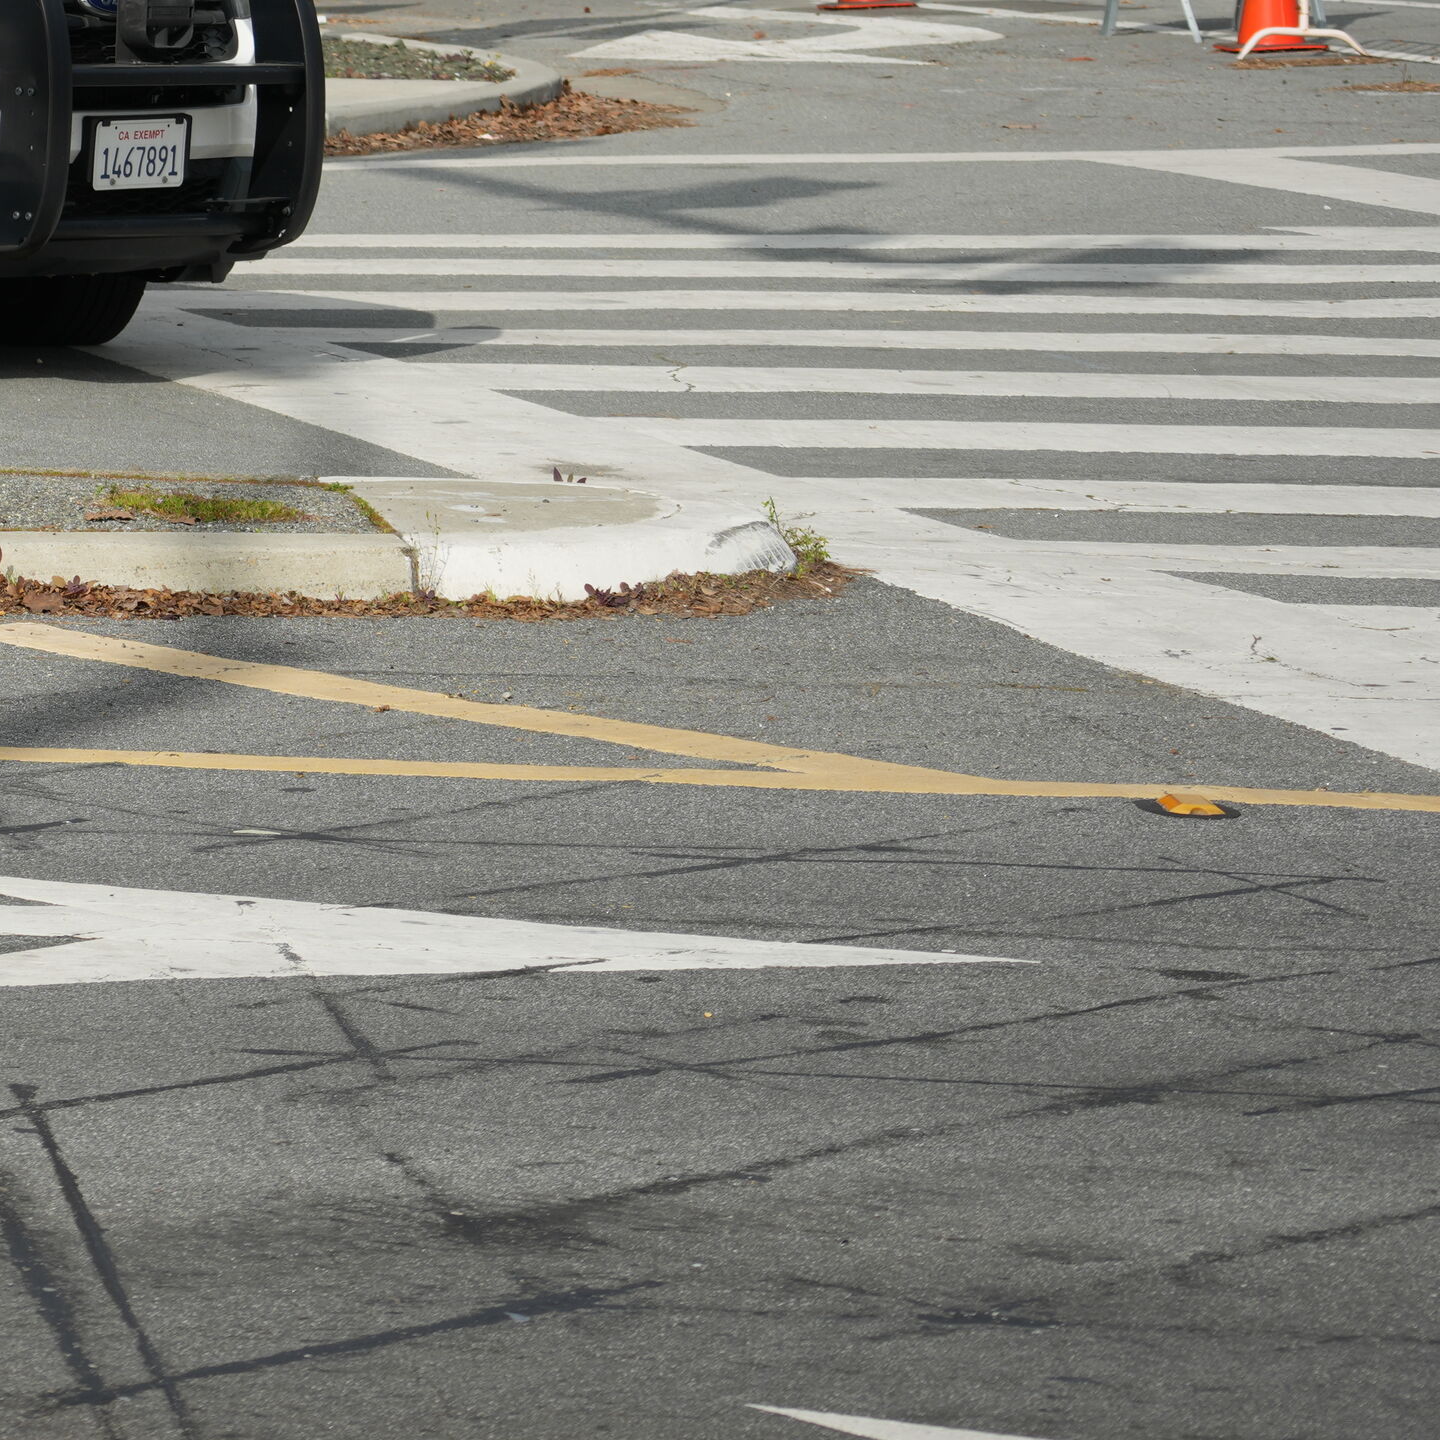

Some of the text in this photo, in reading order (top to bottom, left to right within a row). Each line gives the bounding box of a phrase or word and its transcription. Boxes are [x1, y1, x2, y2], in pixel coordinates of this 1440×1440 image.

[118, 129, 165, 141] CA EXEMPT
[100, 144, 178, 179] 1467891
